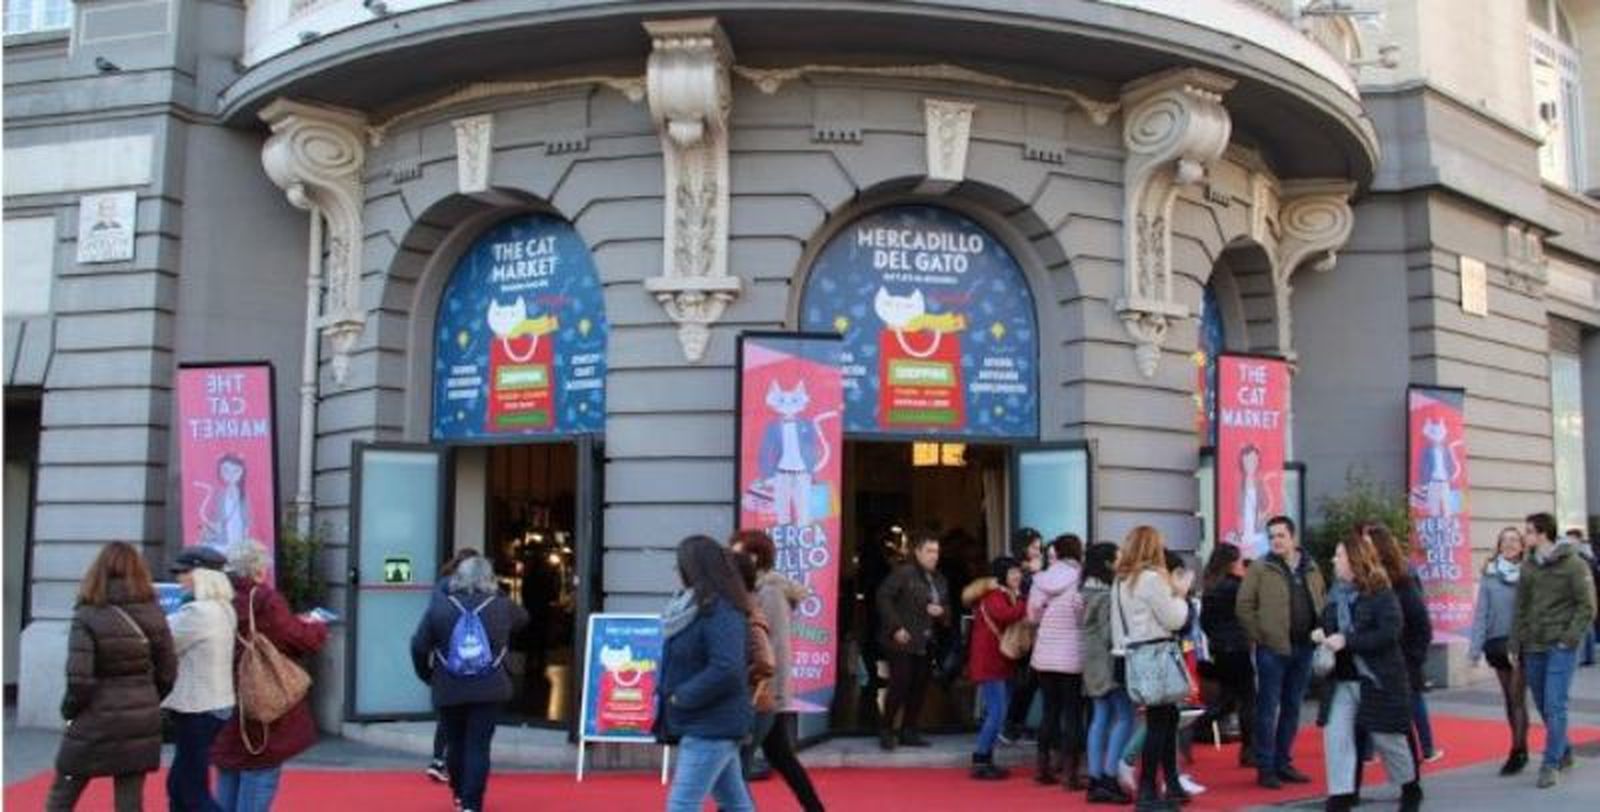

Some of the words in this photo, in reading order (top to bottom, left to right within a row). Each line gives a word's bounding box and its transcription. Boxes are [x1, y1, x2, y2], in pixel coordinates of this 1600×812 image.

[493, 240, 524, 262] THE
[526, 236, 557, 256] CAT
[857, 228, 984, 254] MERCADILLO
[492, 256, 559, 283] MARKET
[873, 250, 911, 270] DEL
[915, 253, 969, 273] GATO
[1238, 363, 1268, 384] THE
[1236, 387, 1267, 405] CAT
[1220, 406, 1281, 429] MARKET
[766, 525, 827, 549] ERCA
